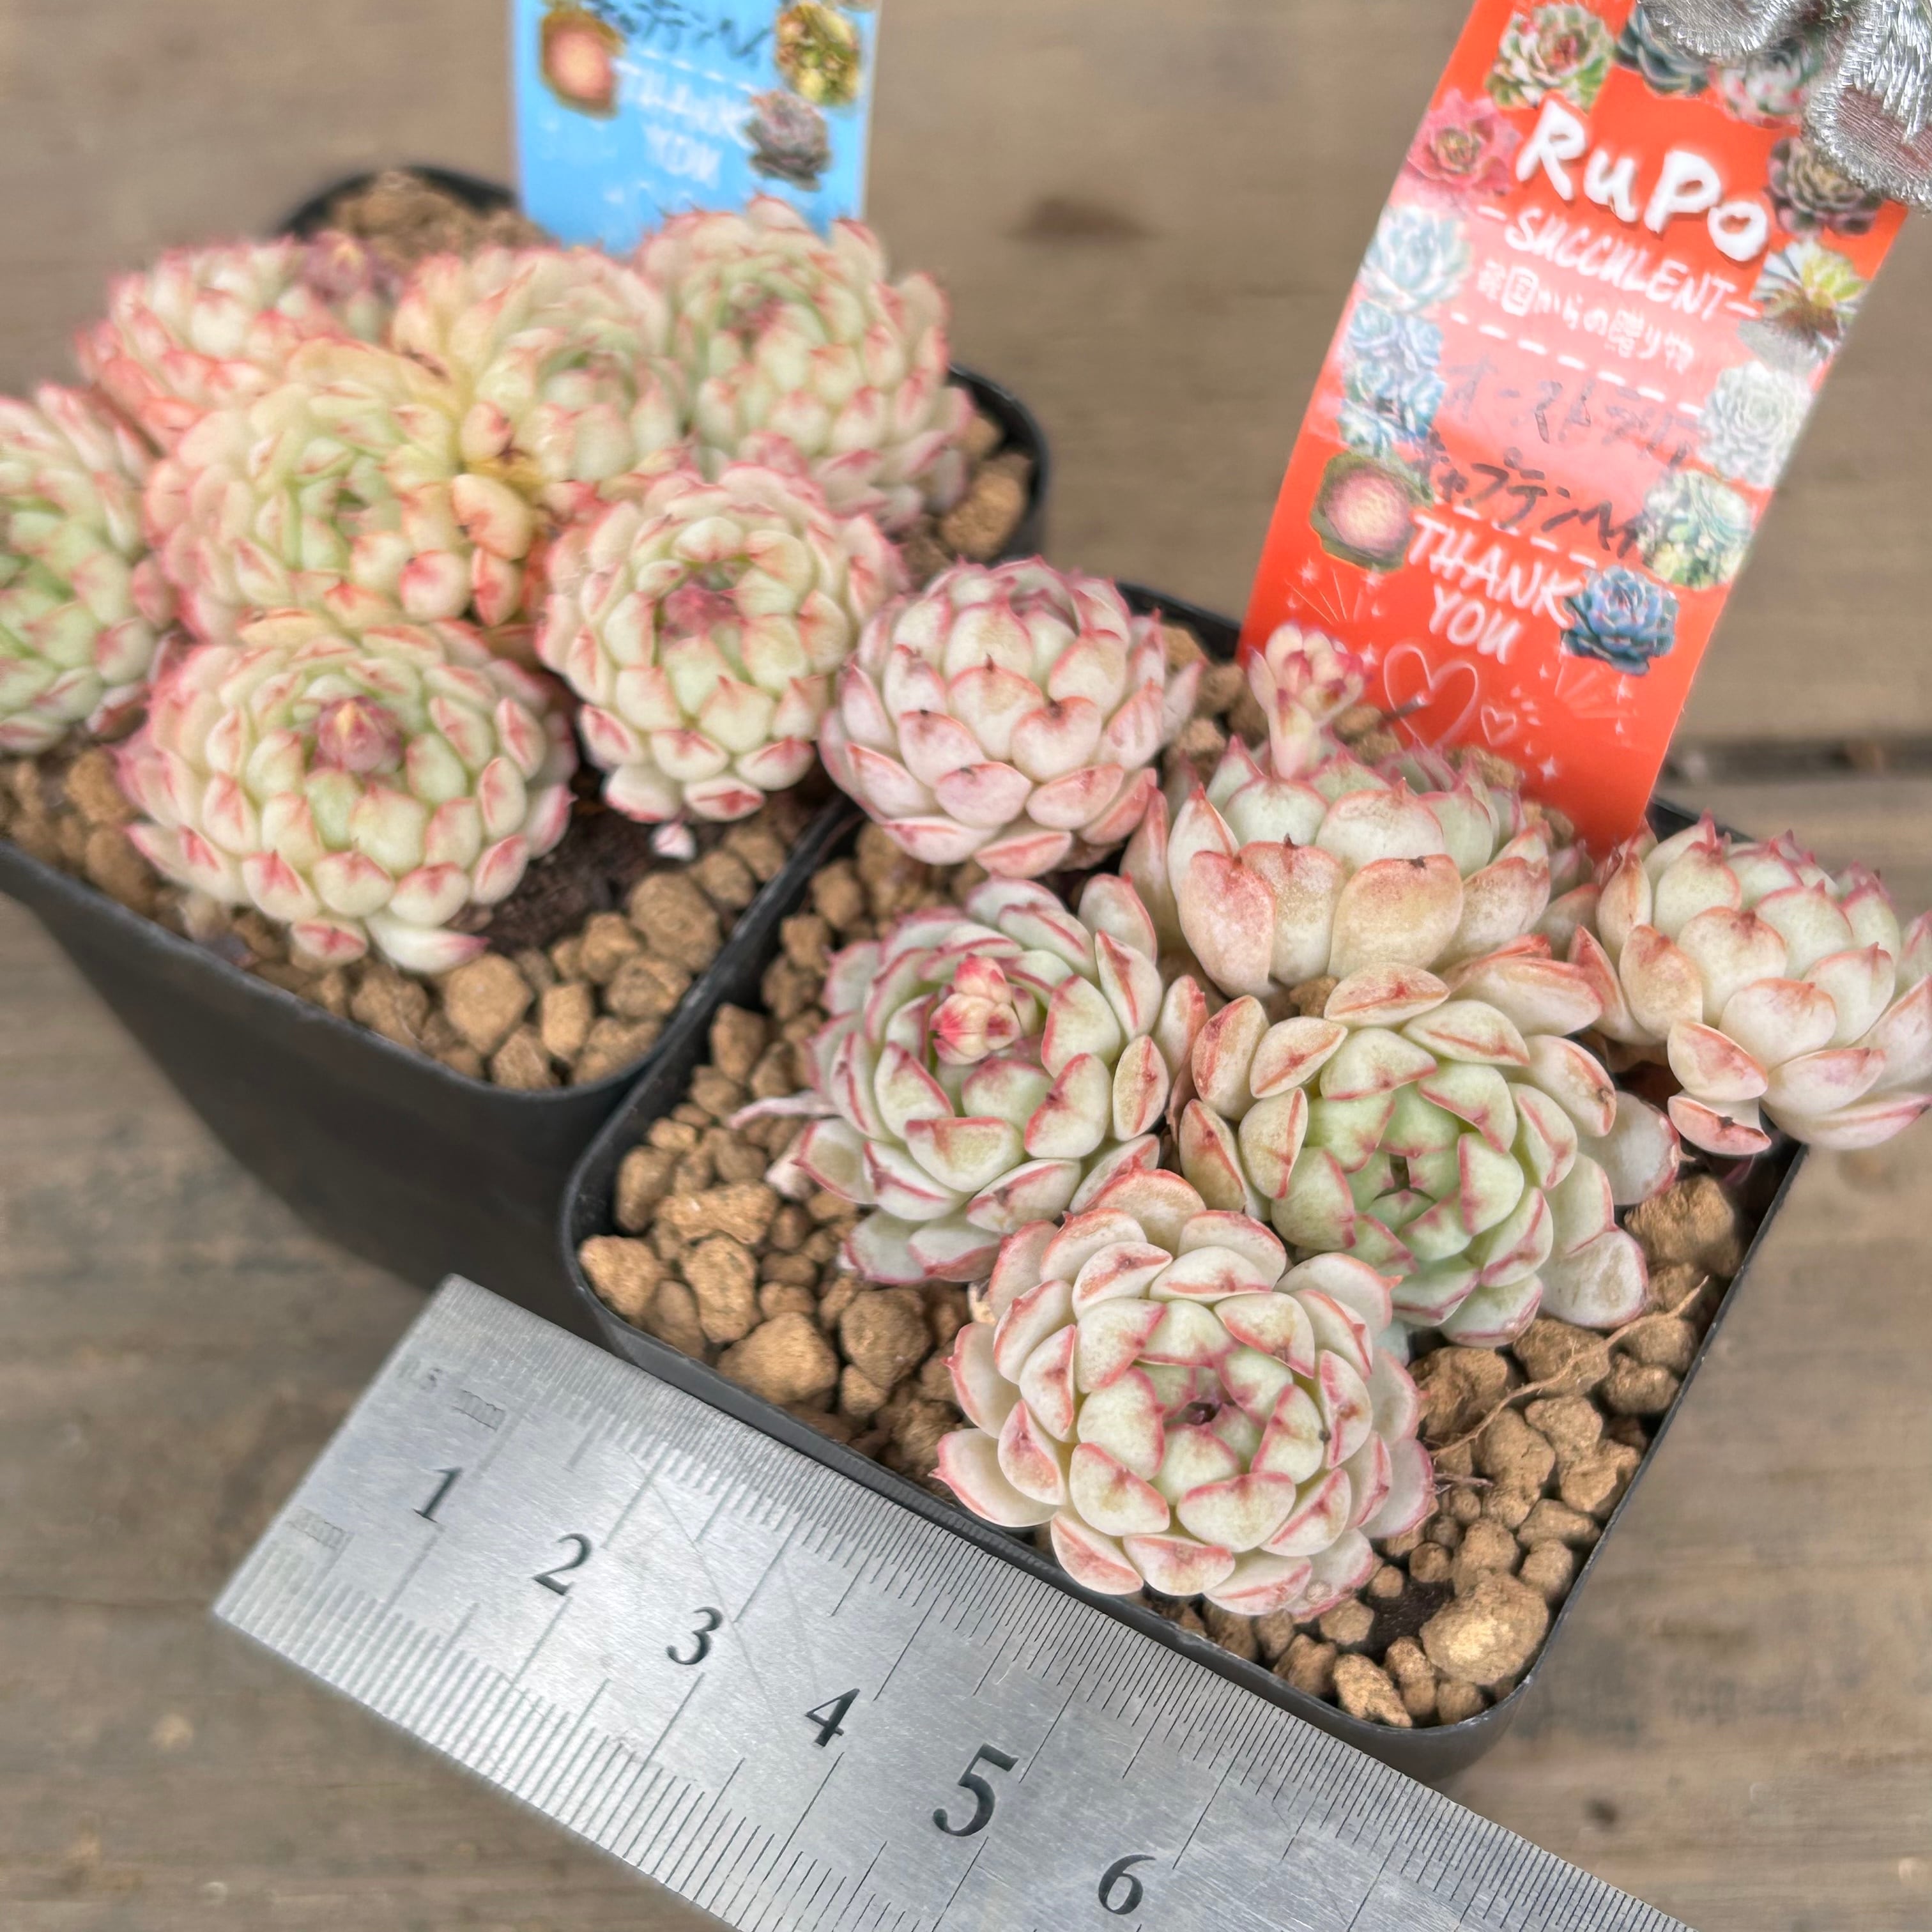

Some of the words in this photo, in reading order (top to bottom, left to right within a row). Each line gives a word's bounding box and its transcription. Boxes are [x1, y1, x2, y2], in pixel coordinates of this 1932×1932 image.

[1515, 98, 1768, 262] RuPo
[1408, 513, 1583, 629] THANK
[1429, 583, 1522, 664] YOU
[413, 1467, 463, 1524] 1
[532, 1533, 593, 1596] 2
[666, 1606, 724, 1665] 3
[804, 1688, 861, 1747] 4
[932, 1742, 1019, 1837] 5
[1098, 1854, 1156, 1915] 6
